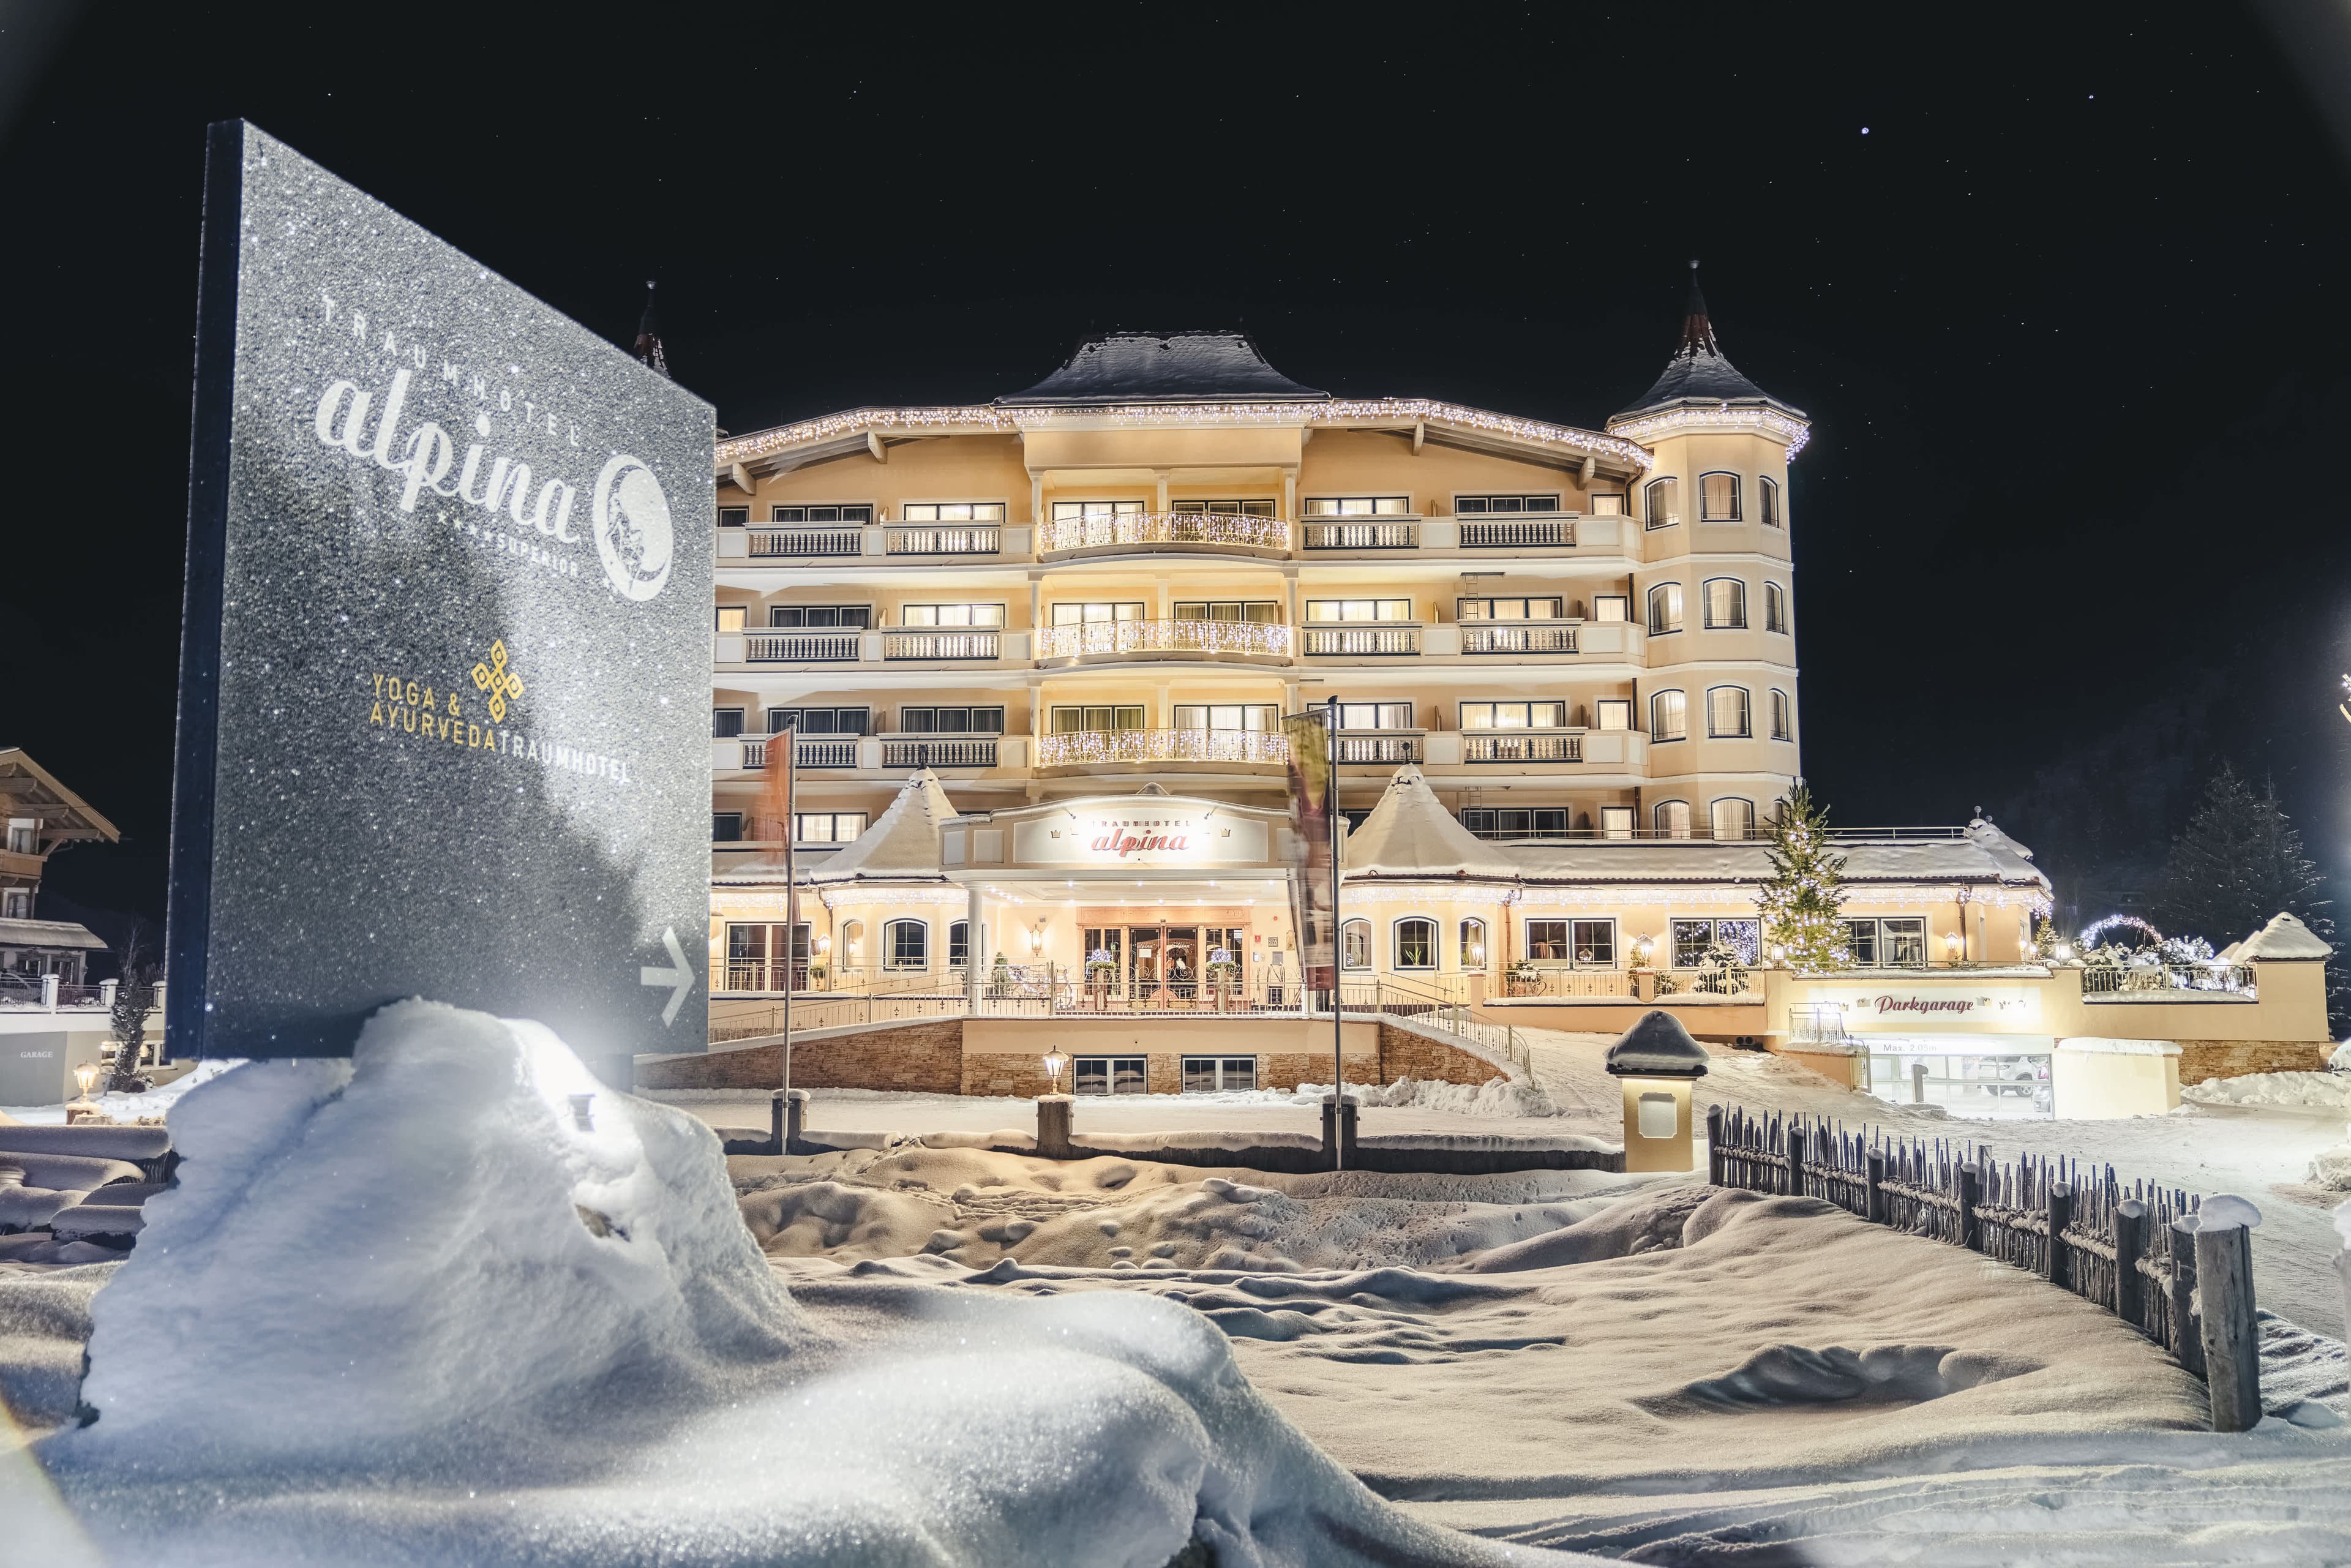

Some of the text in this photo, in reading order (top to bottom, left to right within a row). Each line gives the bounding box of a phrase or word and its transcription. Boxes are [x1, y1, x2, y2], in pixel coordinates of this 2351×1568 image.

[323, 295, 579, 447] TRAUMHOTEL
[315, 369, 581, 543] alpina
[497, 532, 578, 577] SUPERIOR
[373, 673, 460, 717] YOGA &
[1091, 828, 1190, 858] alpina
[1874, 996, 1974, 1015] Parkgarage
